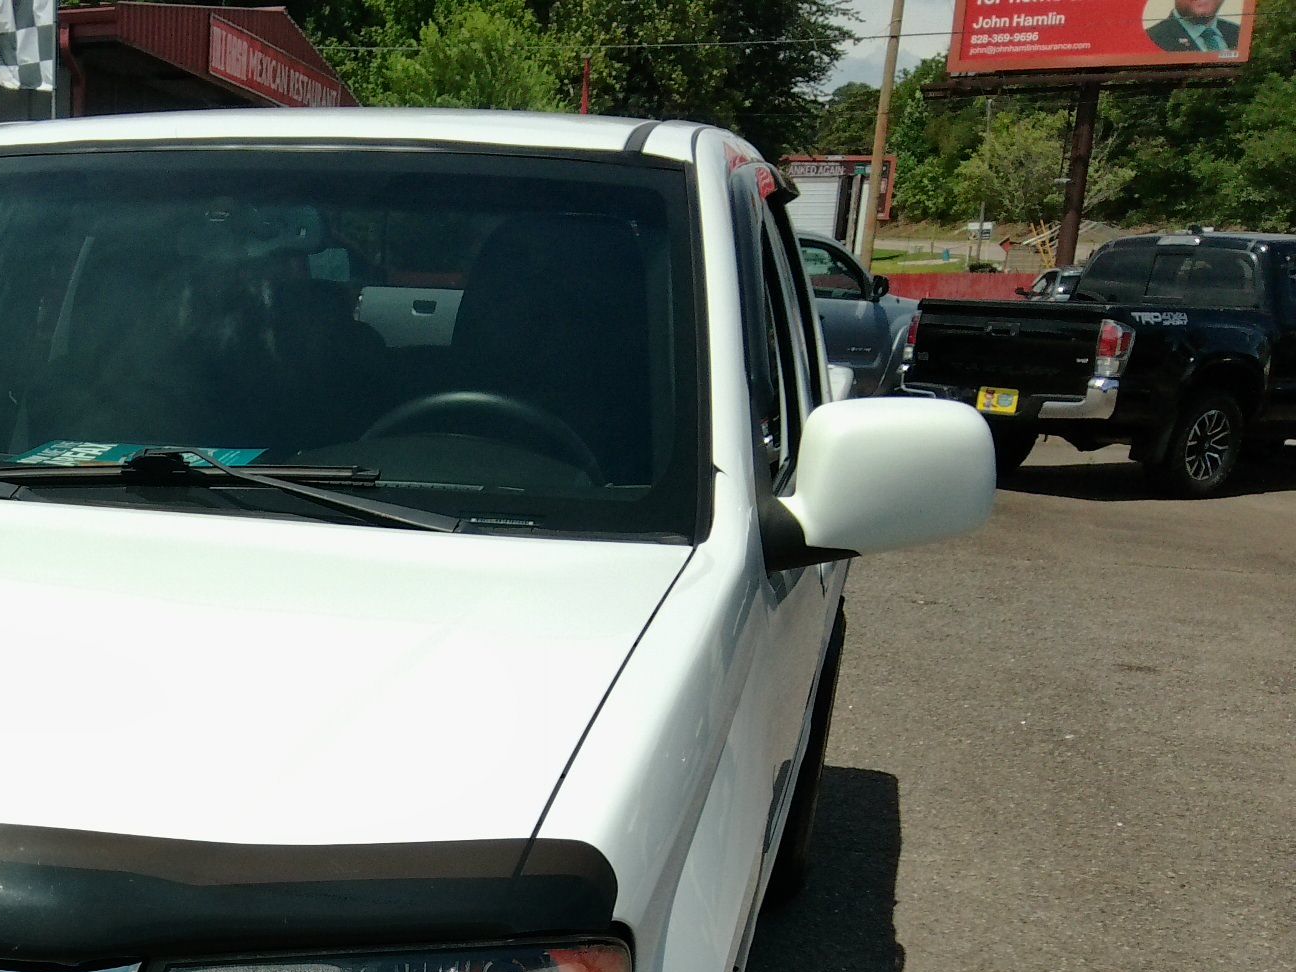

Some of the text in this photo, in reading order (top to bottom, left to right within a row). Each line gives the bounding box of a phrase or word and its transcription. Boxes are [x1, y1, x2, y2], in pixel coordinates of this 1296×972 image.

[972, 12, 1065, 29] John Hamlin
[249, 46, 289, 95] MEXICAN
[1131, 311, 1163, 325] TRD
